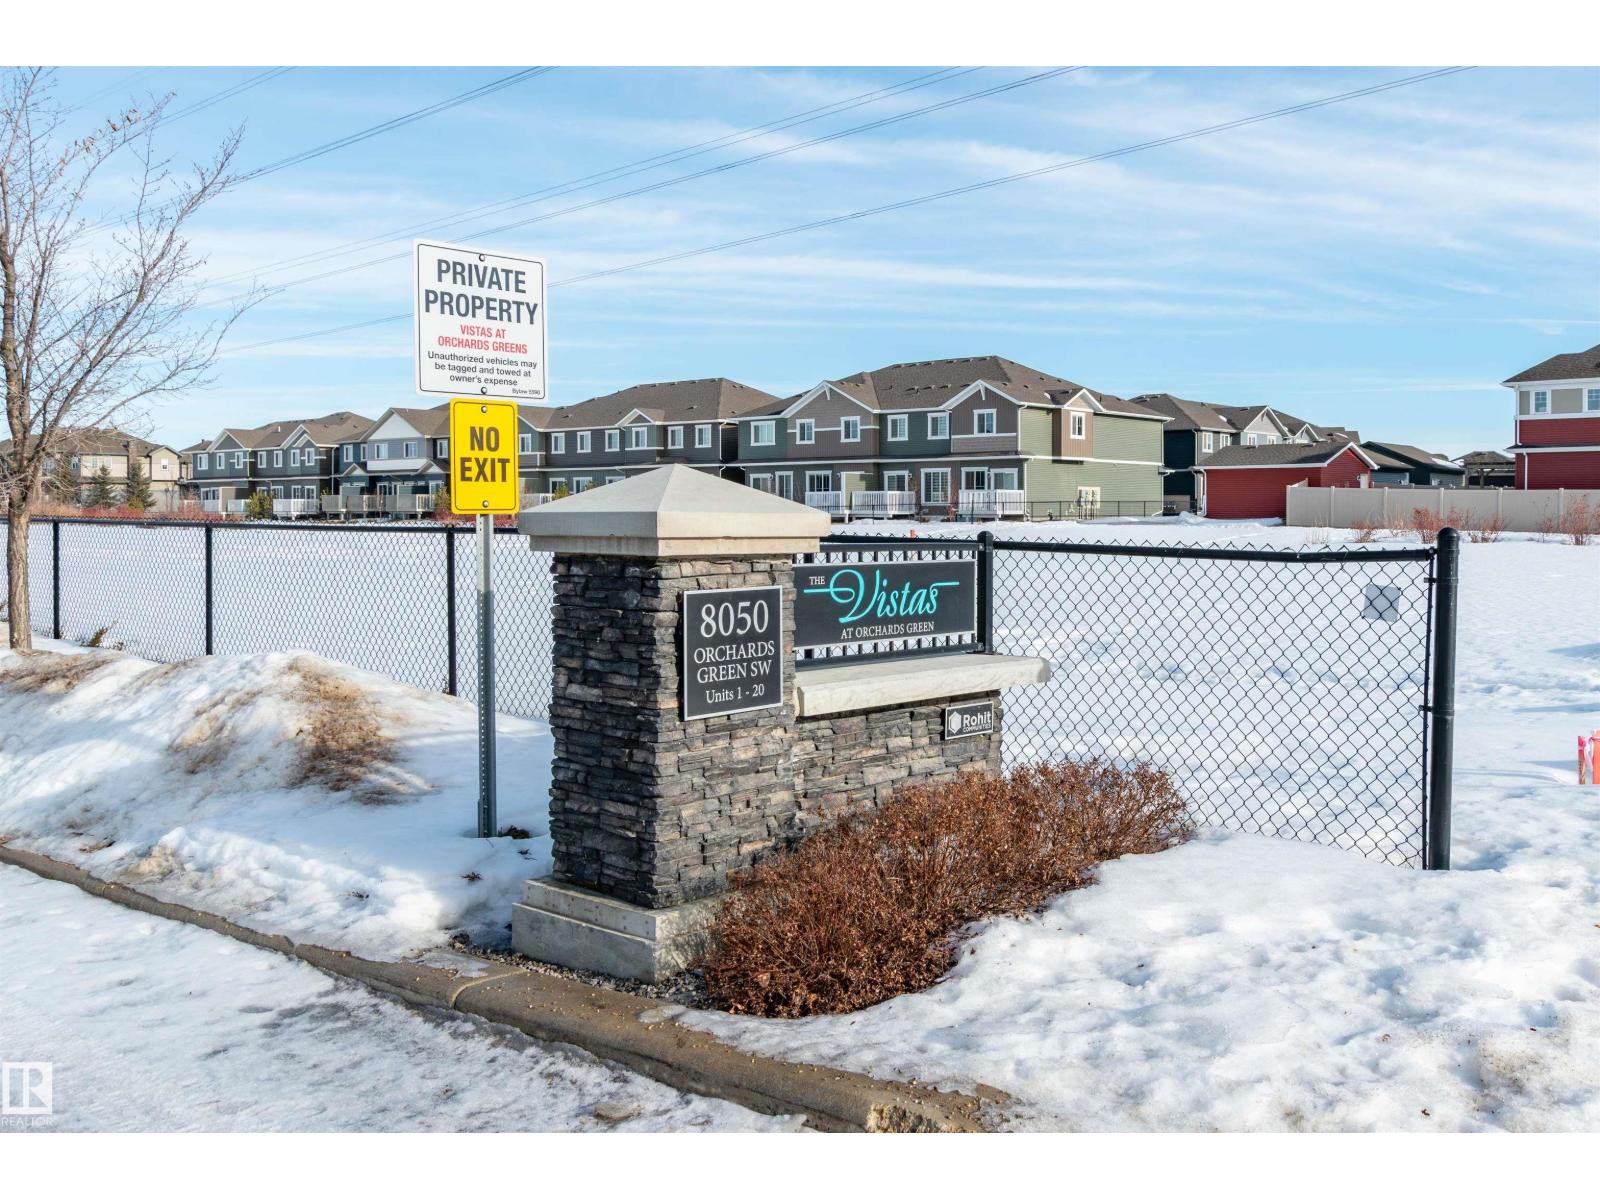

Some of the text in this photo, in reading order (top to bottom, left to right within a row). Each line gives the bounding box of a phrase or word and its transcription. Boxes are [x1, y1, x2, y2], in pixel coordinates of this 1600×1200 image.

[437, 259, 527, 293] PRIVATE
[425, 289, 538, 325] PROPERTY
[460, 324, 507, 339] VISTAS AT
[438, 336, 528, 354] ORCHARDS GREENS
[428, 351, 537, 369] Unauthorized vehicles may
[435, 362, 446, 370] be
[448, 364, 477, 374] tagged
[479, 366, 494, 375] and
[496, 368, 521, 377] towed
[450, 374, 518, 386] owner's expense
[470, 426, 500, 452] NO
[460, 457, 510, 483] EXIT
[809, 576, 825, 585] THE
[803, 569, 960, 624] Vistas
[700, 600, 769, 638] 8050
[841, 621, 935, 639] AT ORCHARDS GREEN
[694, 640, 775, 664] ORCHARDS
[697, 659, 772, 684] GREEN SW
[706, 689, 734, 704] Units
[737, 686, 742, 699] 1
[752, 683, 765, 697] 20
[963, 711, 992, 727] Rohit
